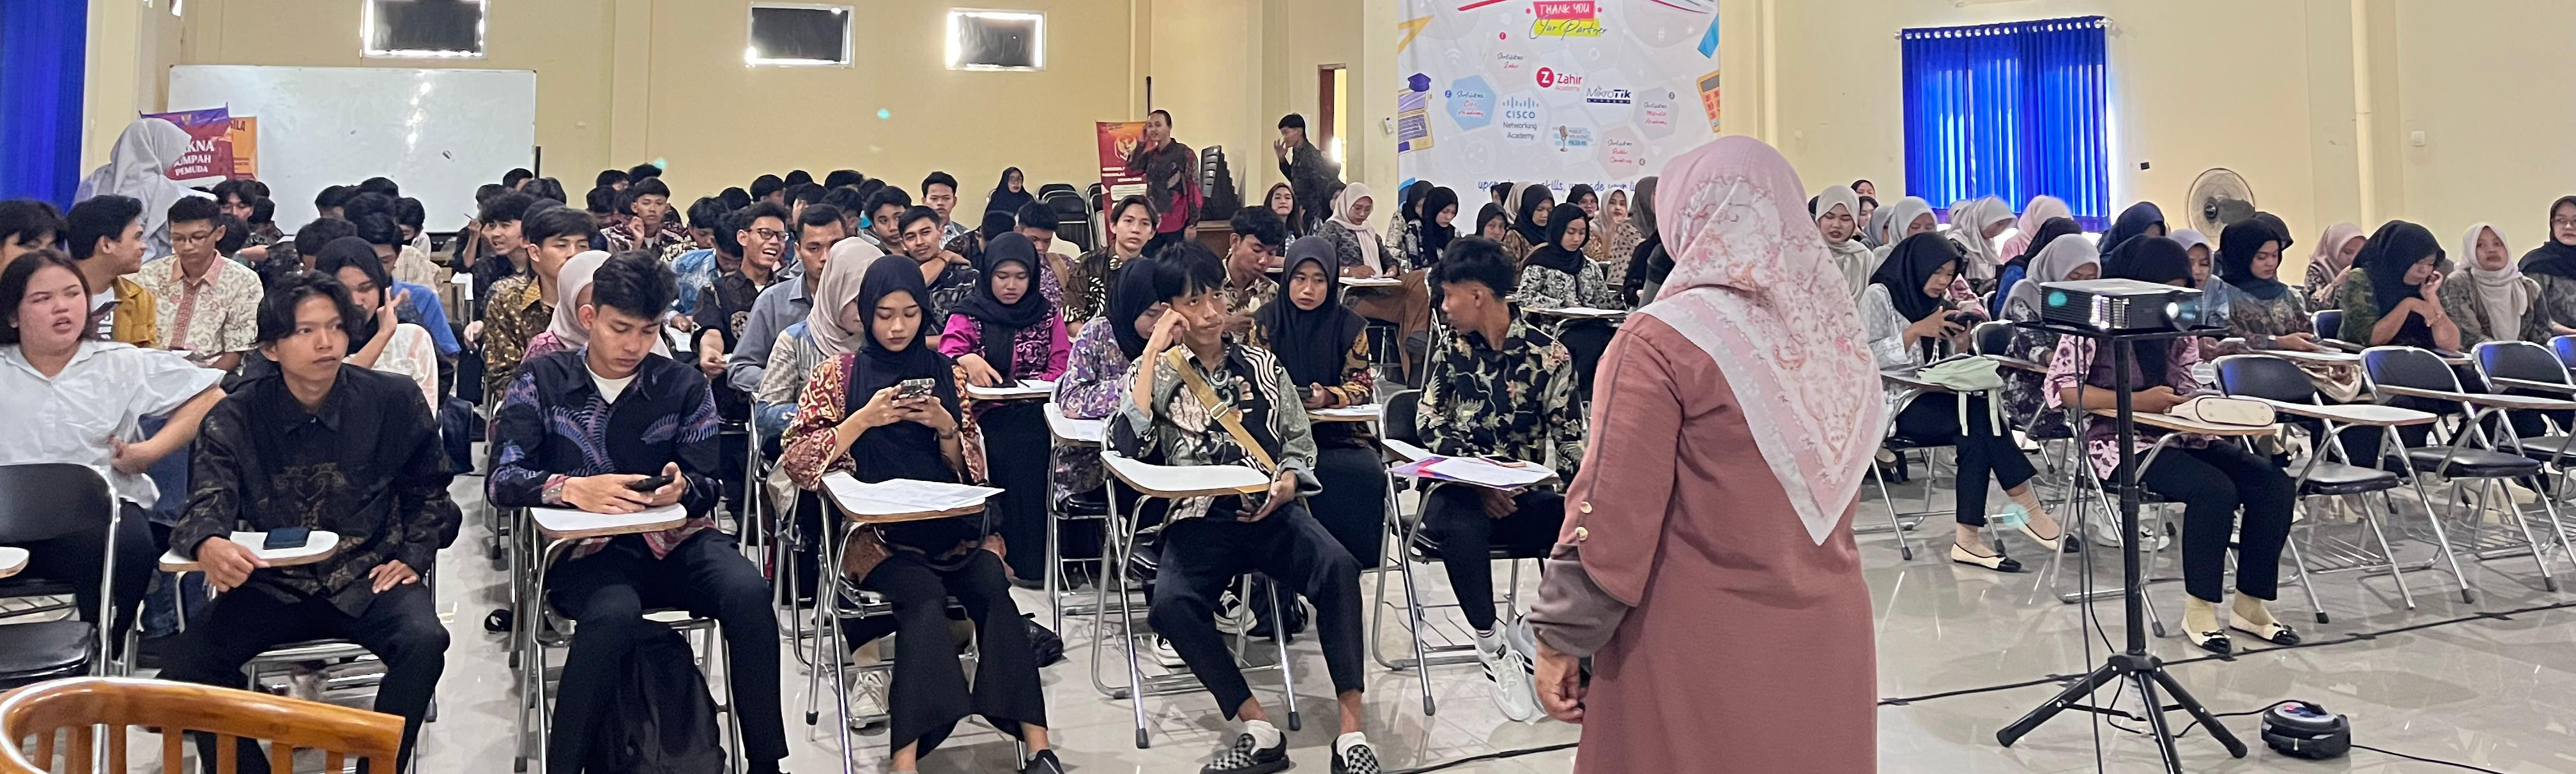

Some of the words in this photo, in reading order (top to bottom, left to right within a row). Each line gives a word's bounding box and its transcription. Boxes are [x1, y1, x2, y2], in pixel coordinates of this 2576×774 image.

[1540, 4, 1570, 15] THANK
[1572, 3, 1590, 13] YOU
[1529, 13, 1557, 39] Our
[1559, 18, 1607, 40] Partner
[1557, 72, 1582, 84] Zahir
[1506, 110, 1535, 119] CISCO
[1503, 121, 1537, 130] Networking
[1507, 132, 1534, 140] Academy
[174, 166, 208, 176] PEMUDA
